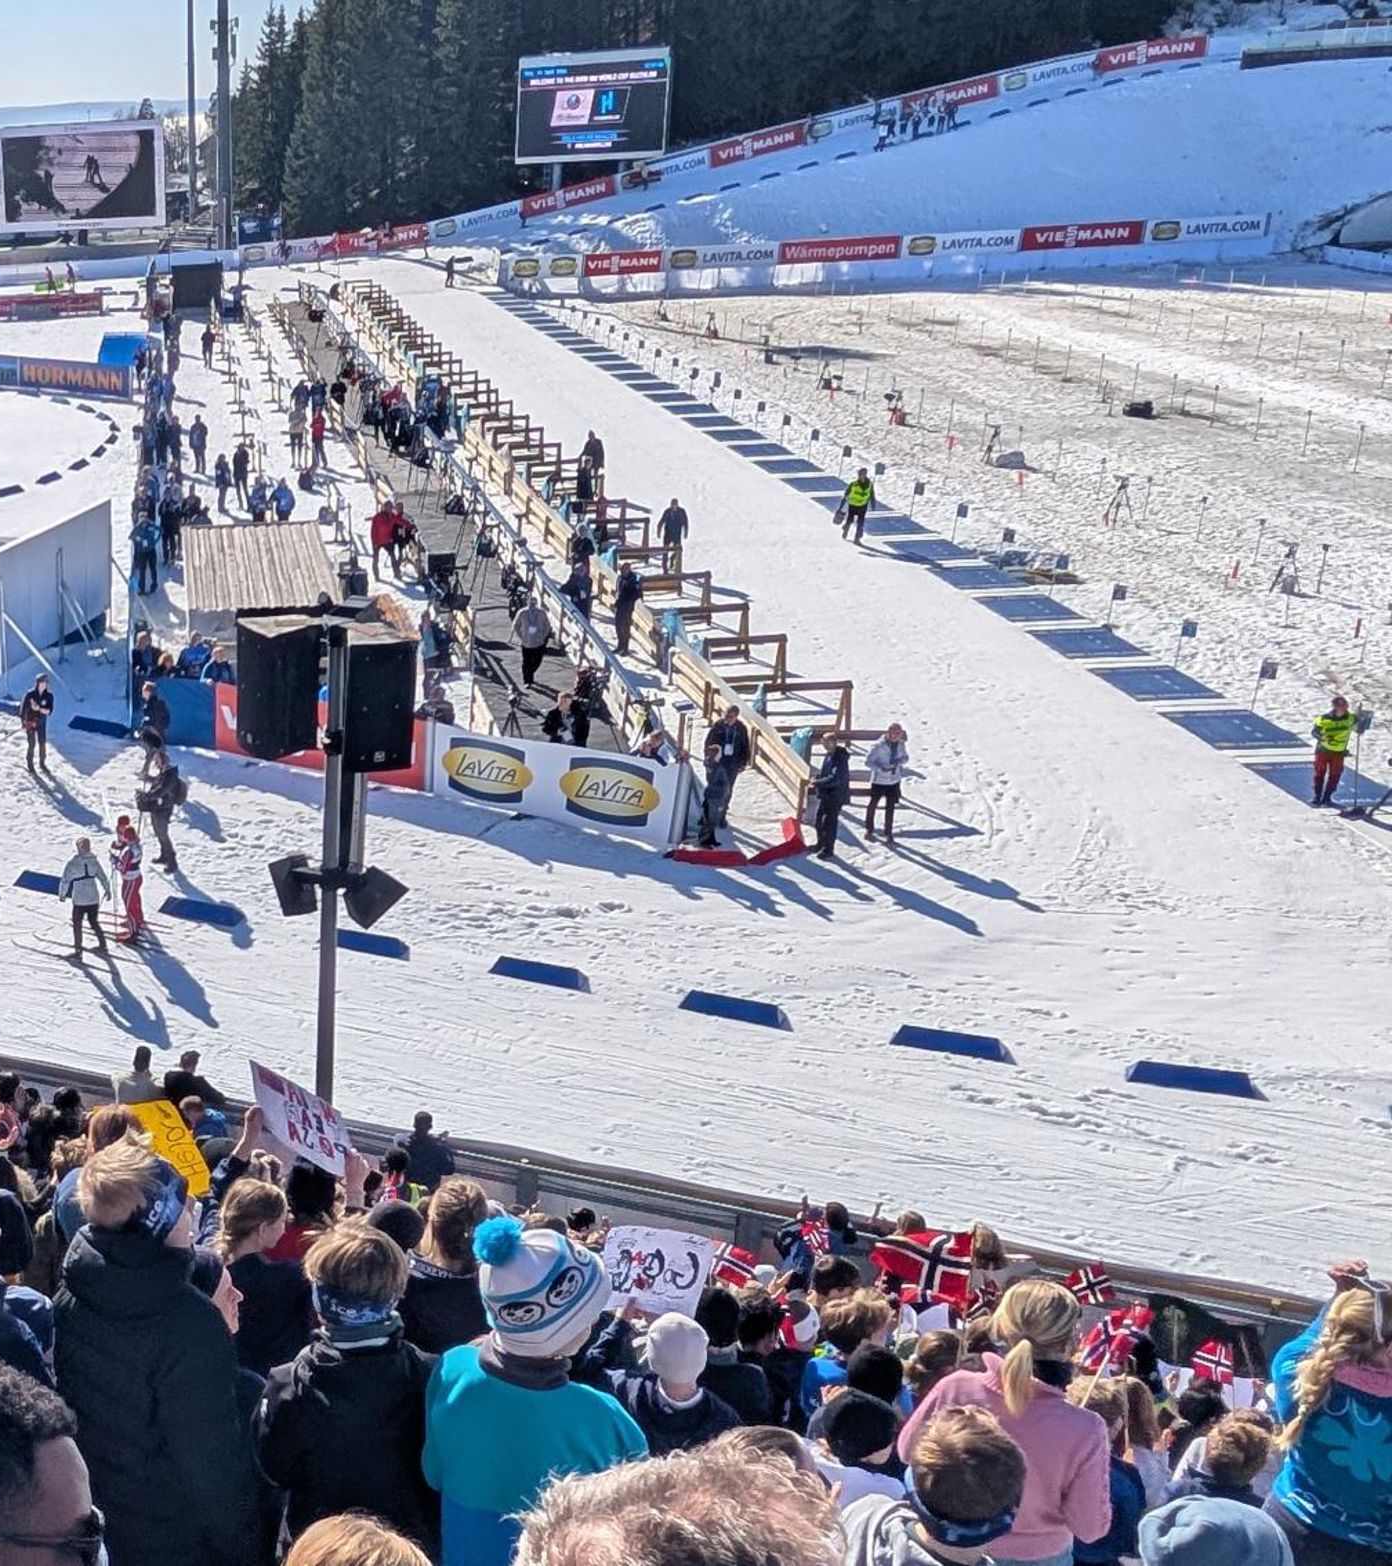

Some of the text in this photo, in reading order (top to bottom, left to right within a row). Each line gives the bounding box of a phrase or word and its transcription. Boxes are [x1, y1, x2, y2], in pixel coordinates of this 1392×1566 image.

[1185, 219, 1261, 235] LAVITA.COM
[941, 234, 1015, 250] LAVITA.COM
[1034, 225, 1130, 248] VIESSMANN
[702, 249, 774, 264] LAVITA.COM
[784, 240, 896, 261] Wärmepumpen
[587, 255, 658, 273] VIESSMANN
